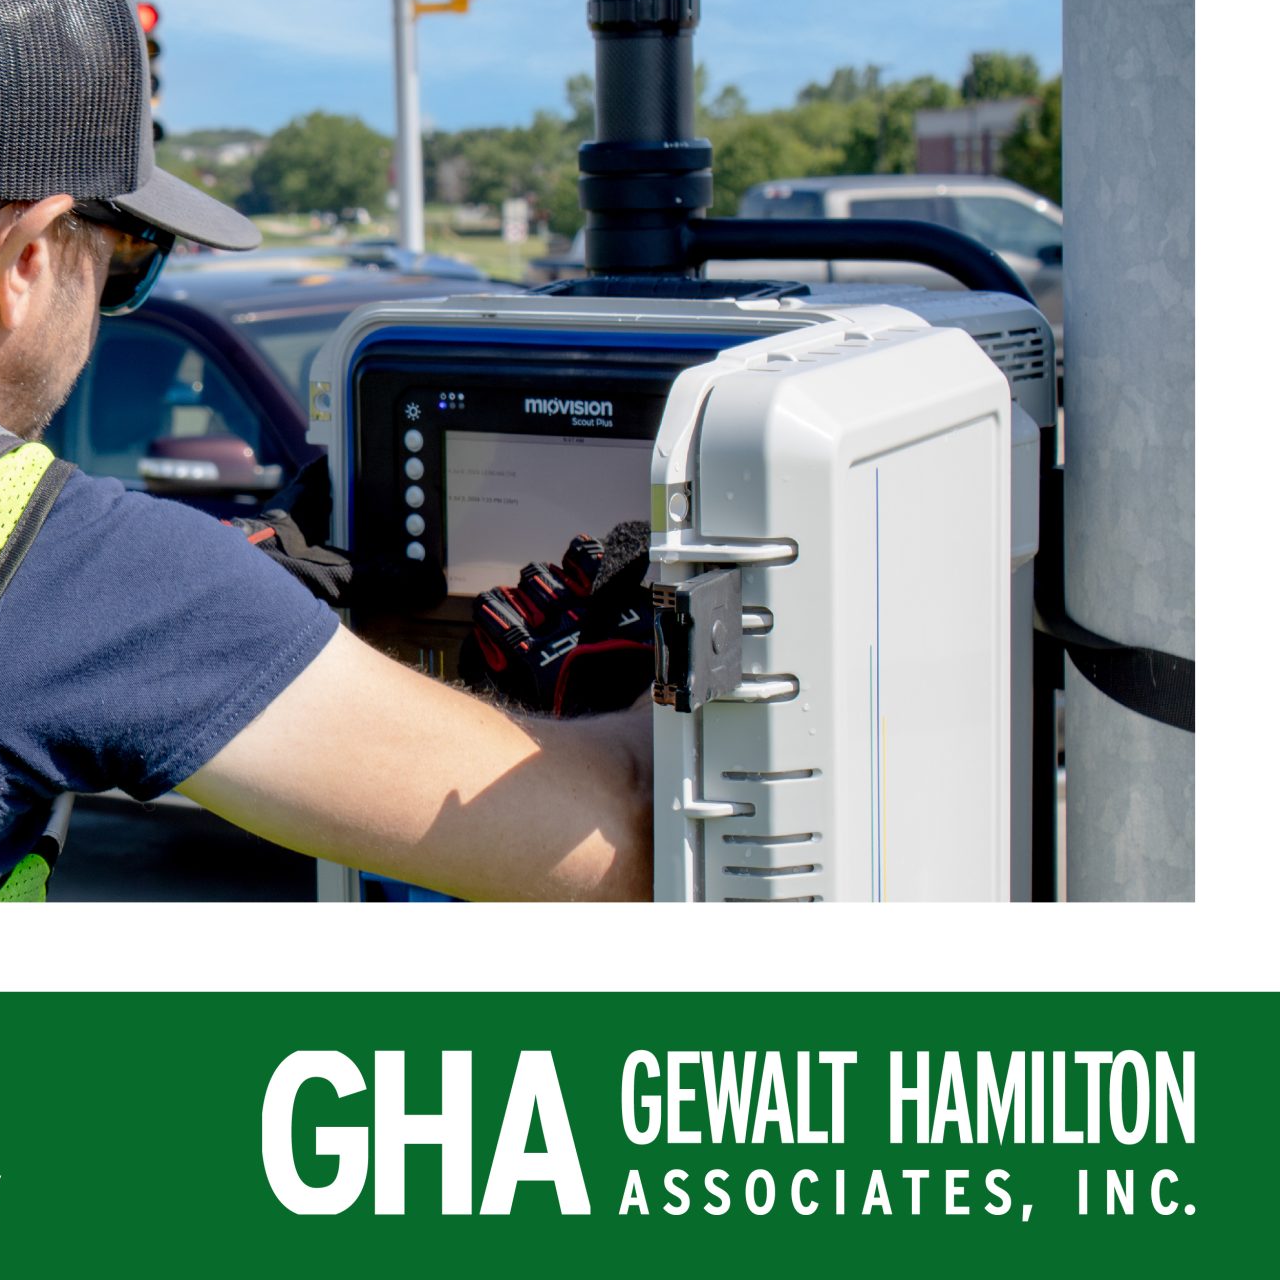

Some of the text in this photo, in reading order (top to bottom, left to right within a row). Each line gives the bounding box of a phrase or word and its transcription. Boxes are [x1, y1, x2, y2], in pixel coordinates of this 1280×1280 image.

[524, 397, 613, 416] miovision
[571, 417, 613, 428] Scout Plus
